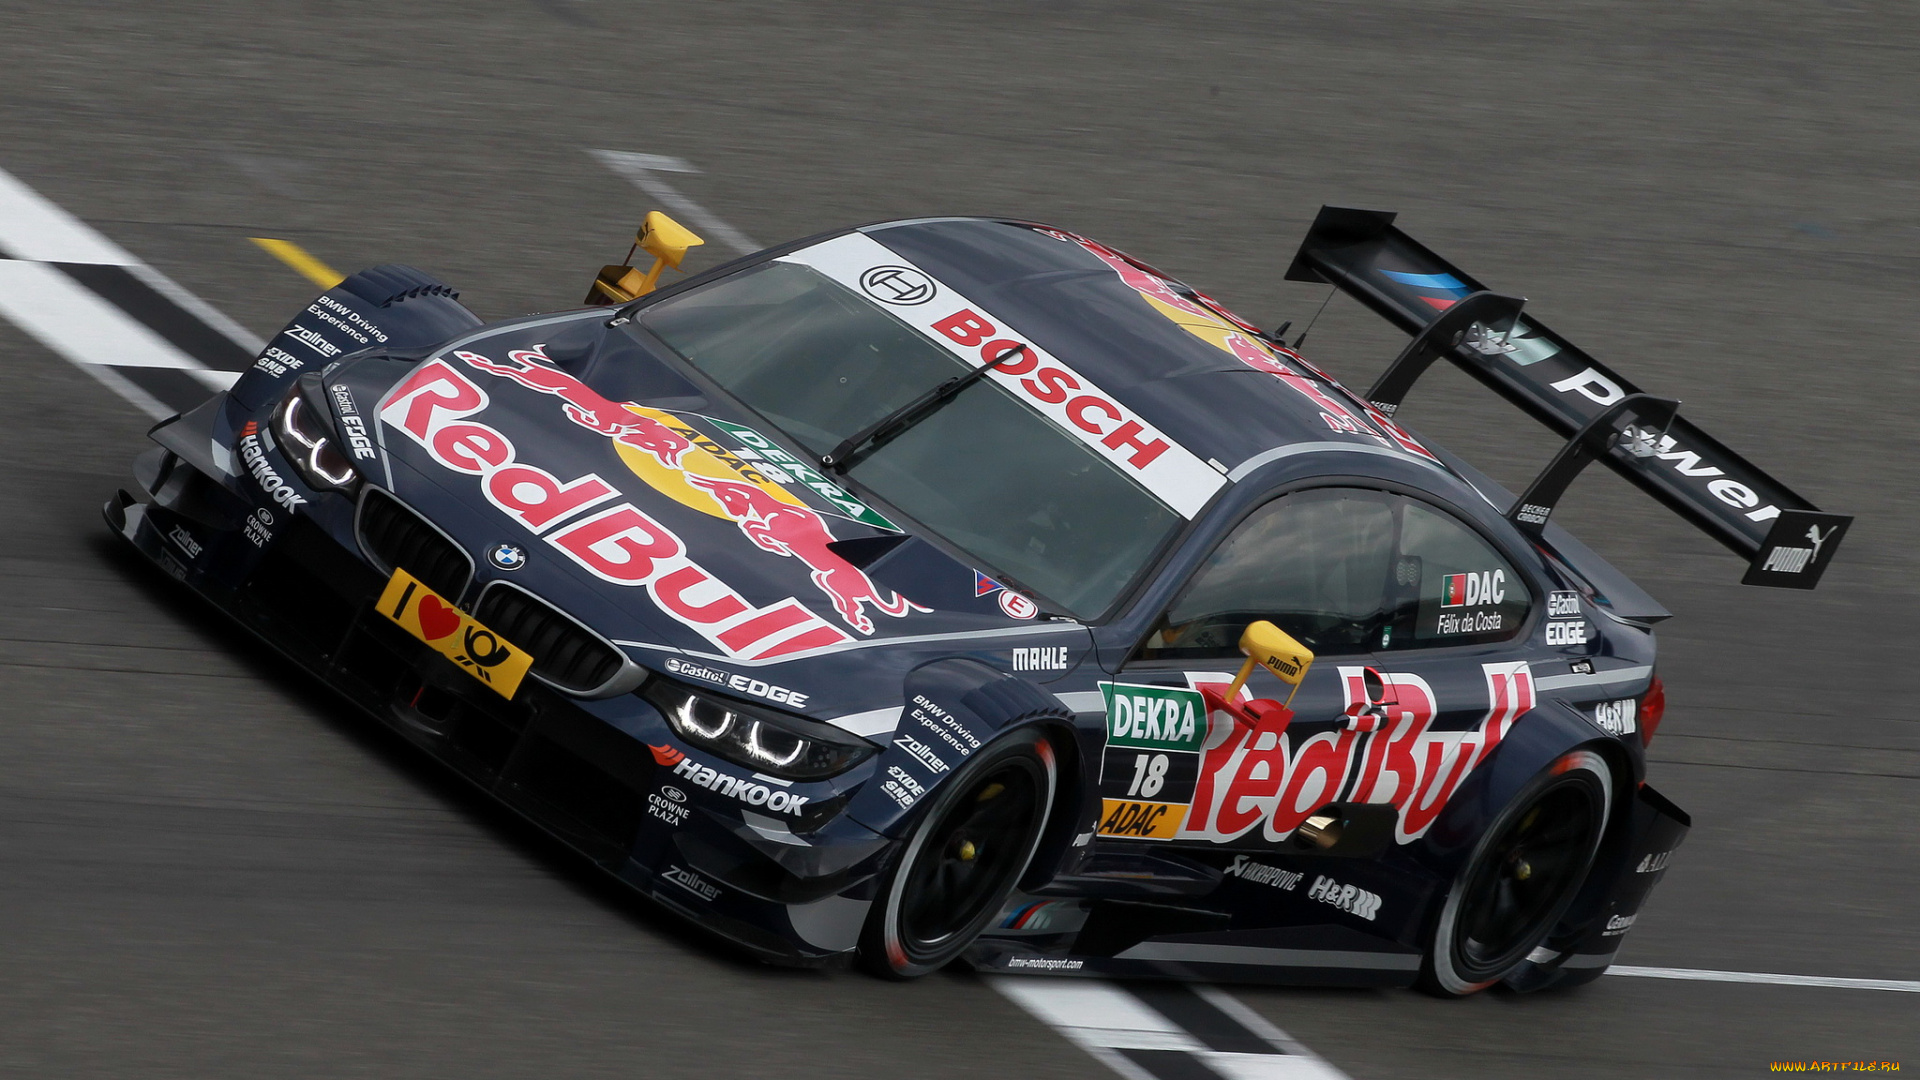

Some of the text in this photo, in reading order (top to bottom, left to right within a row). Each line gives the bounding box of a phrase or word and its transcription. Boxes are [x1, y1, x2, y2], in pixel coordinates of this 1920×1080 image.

[307, 304, 369, 345] Experience
[317, 295, 388, 343] BMW Driving
[258, 357, 287, 375] GNB
[266, 347, 304, 370] EXIDE
[930, 308, 1171, 471] BOSCH
[341, 416, 376, 460] EDGE
[673, 426, 770, 485] ADAC
[731, 447, 795, 485] 18
[731, 430, 866, 519] DEKRA
[381, 359, 857, 664] Red Bull
[243, 525, 263, 548] PLAZA
[246, 514, 273, 543] CROWNE
[1761, 546, 1814, 574] PUMA
[1466, 569, 1505, 606] DAC
[1556, 593, 1581, 616] Castrol
[1437, 611, 1502, 635] Félix da Costa
[1545, 621, 1587, 645] EDGE
[1012, 647, 1068, 671] MAHLE
[1267, 655, 1298, 677] PUMA
[680, 661, 810, 709] Castrol EDGE
[911, 709, 970, 757] Experience
[913, 694, 982, 749] BMW Driving
[1112, 694, 1196, 743] DEKRA
[1184, 661, 1536, 845] Red Bull
[888, 765, 925, 797] EXIDE
[1127, 754, 1170, 798] 18
[648, 793, 690, 820] CROWNE
[885, 780, 915, 806] GNB
[648, 804, 679, 827] PLAZA
[1098, 803, 1168, 836] ADAC
[1008, 956, 1084, 971] bmw-motorsport.com
